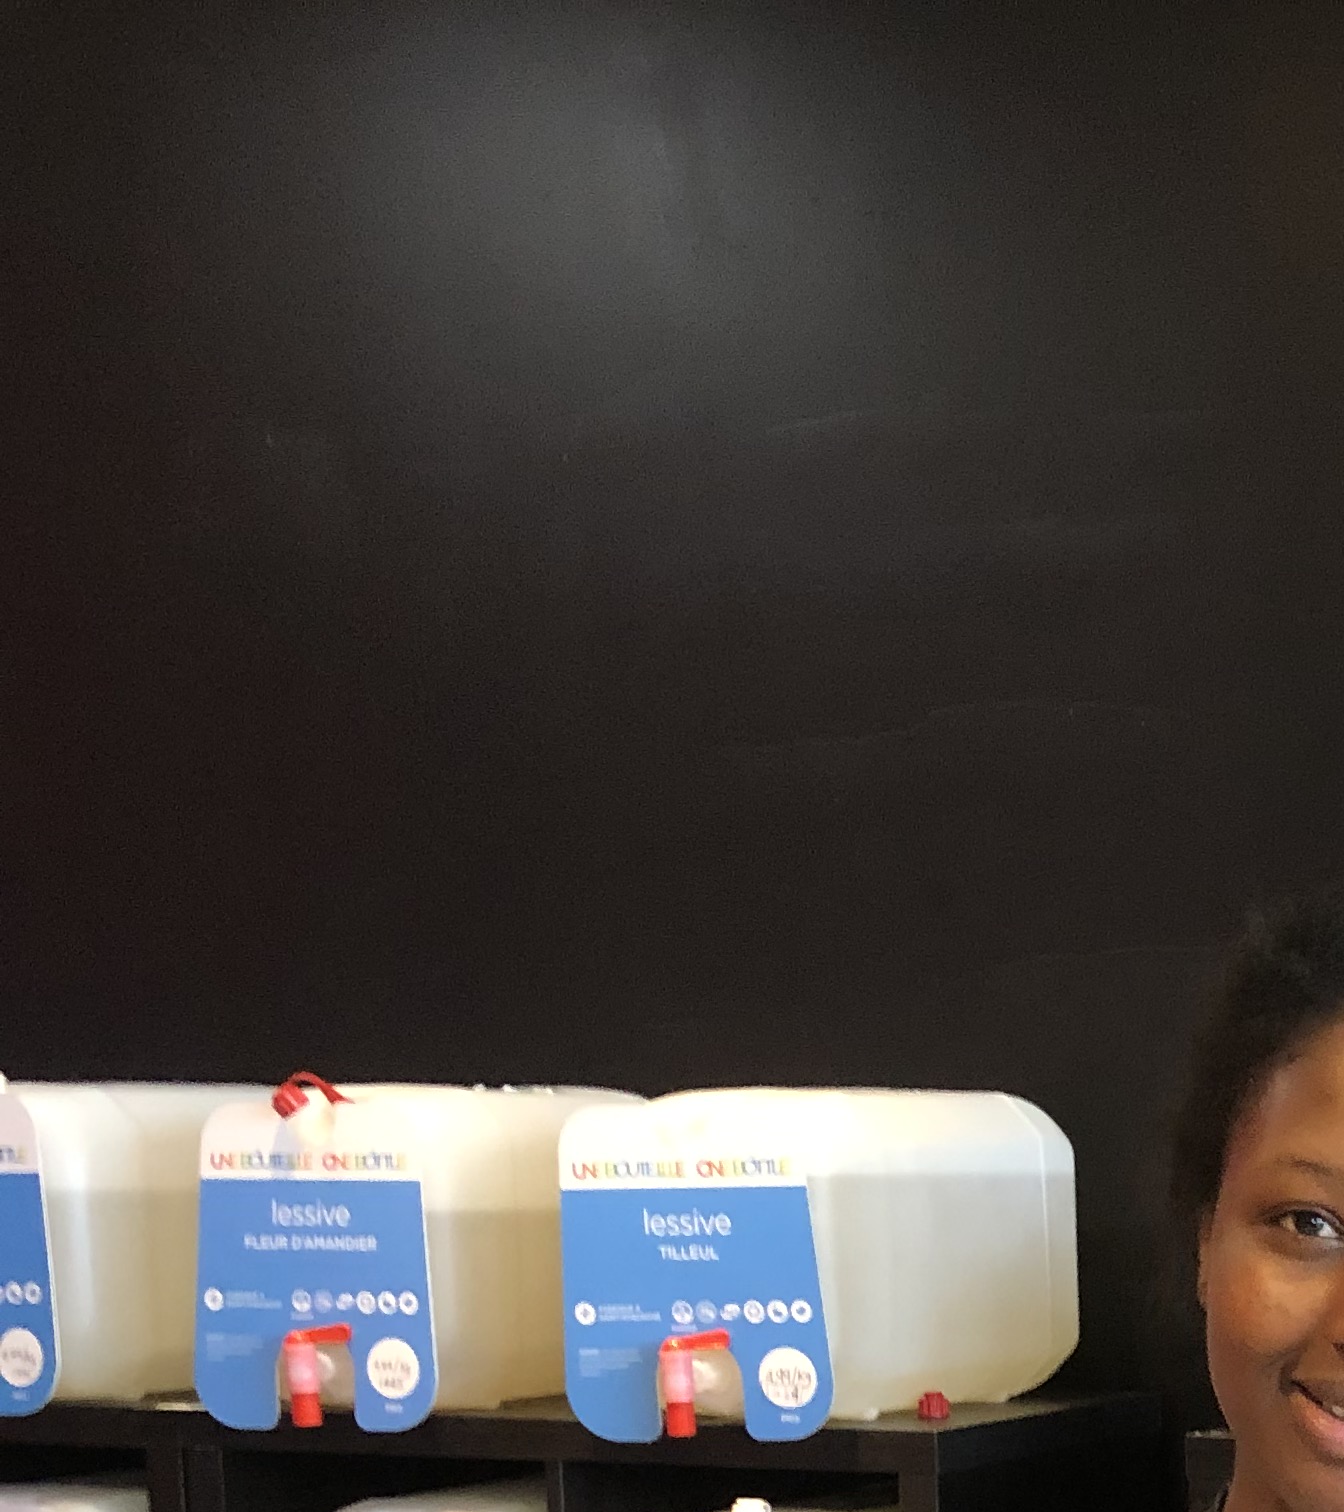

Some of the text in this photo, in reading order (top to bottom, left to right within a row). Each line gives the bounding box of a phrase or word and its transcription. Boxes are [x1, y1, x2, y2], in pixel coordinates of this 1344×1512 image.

[270, 1198, 351, 1227] lessive
[643, 1207, 732, 1237] lessive
[657, 1245, 719, 1261] TILLEUL
